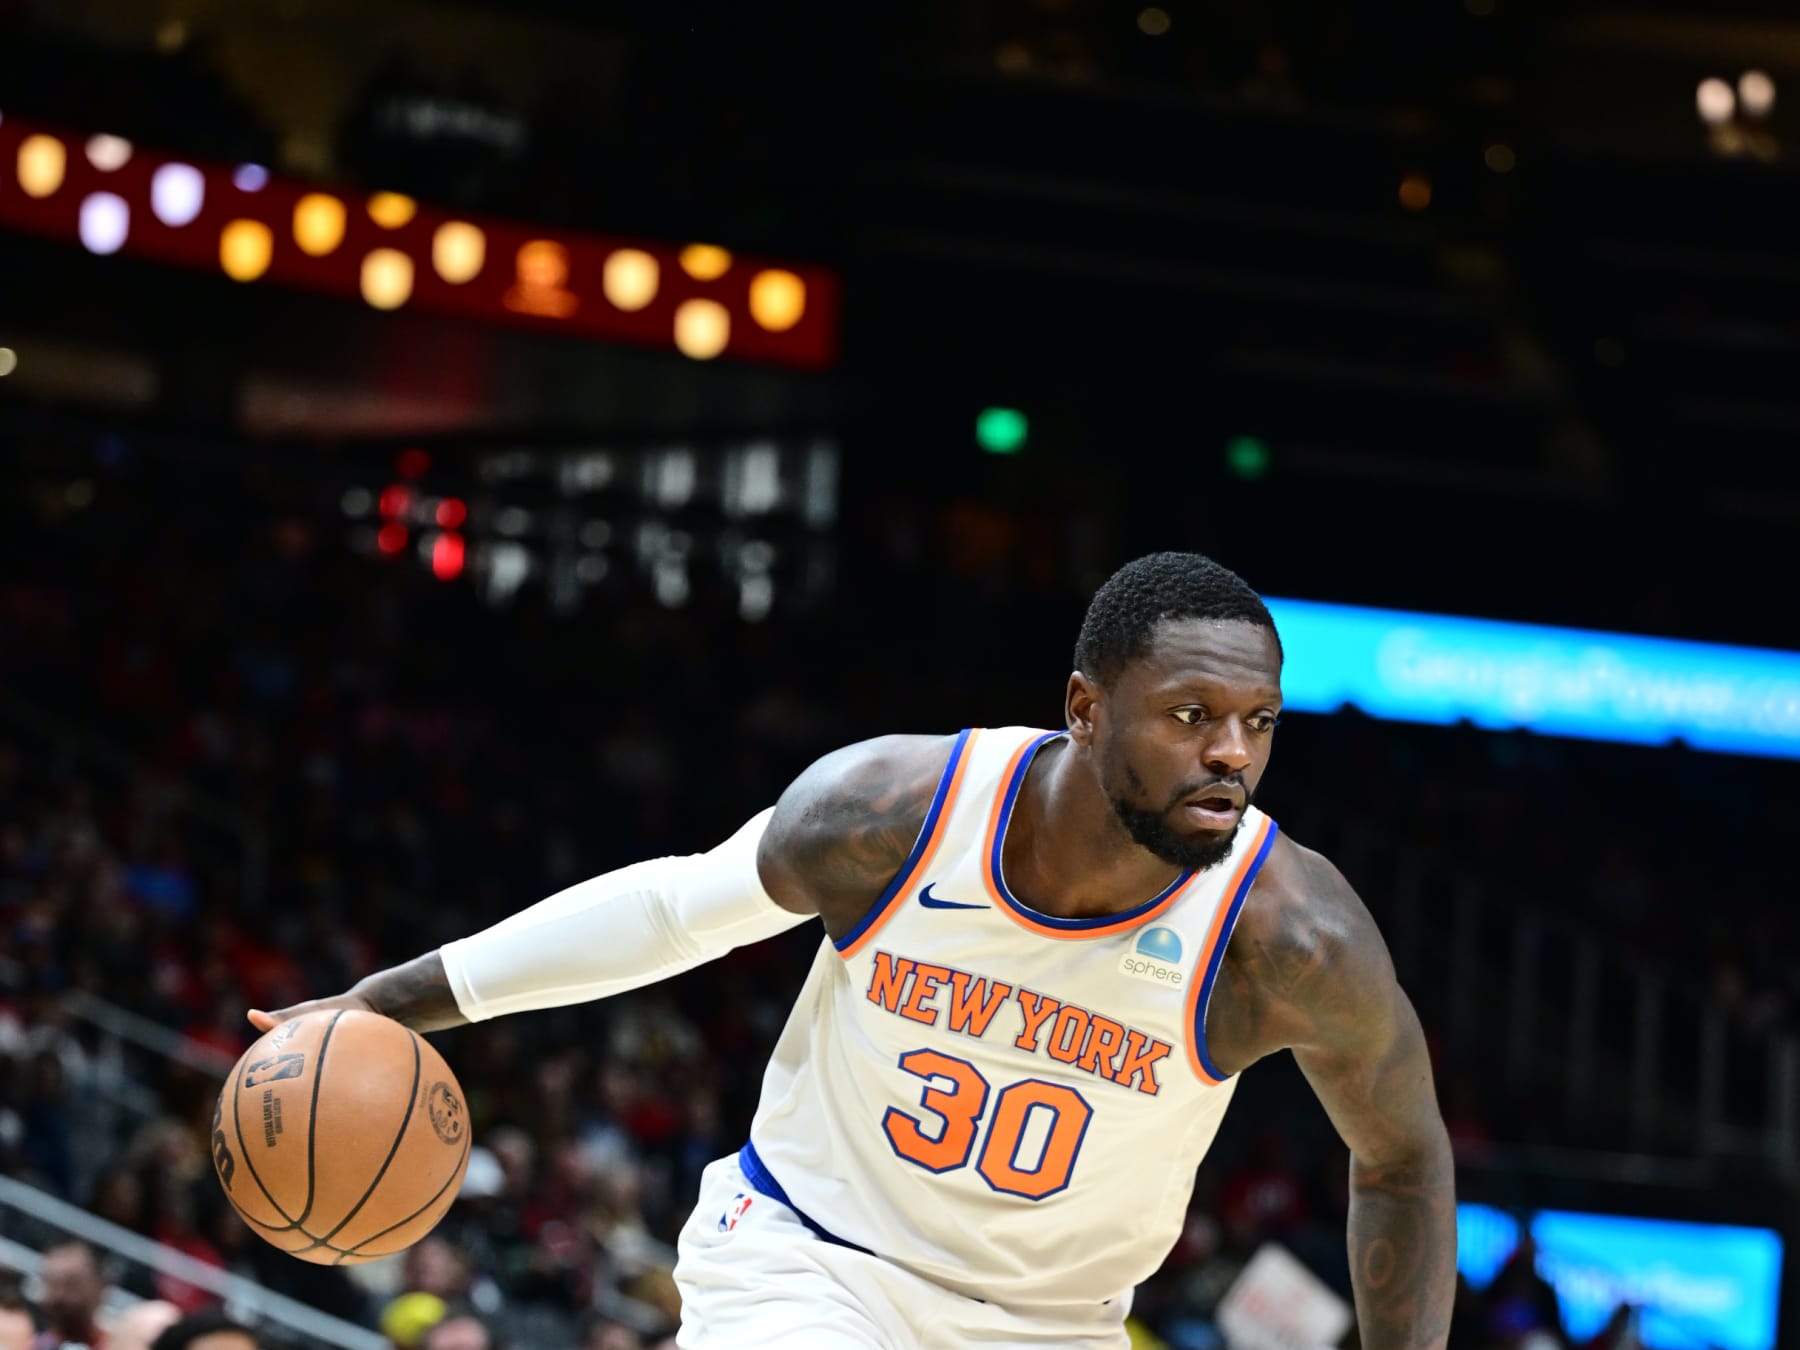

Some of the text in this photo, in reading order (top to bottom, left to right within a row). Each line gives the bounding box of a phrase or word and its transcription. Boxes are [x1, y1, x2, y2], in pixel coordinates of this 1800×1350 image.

[866, 951, 1173, 1097] NEW YORK
[1123, 958, 1183, 984] sphere
[881, 1047, 1094, 1201] 30
